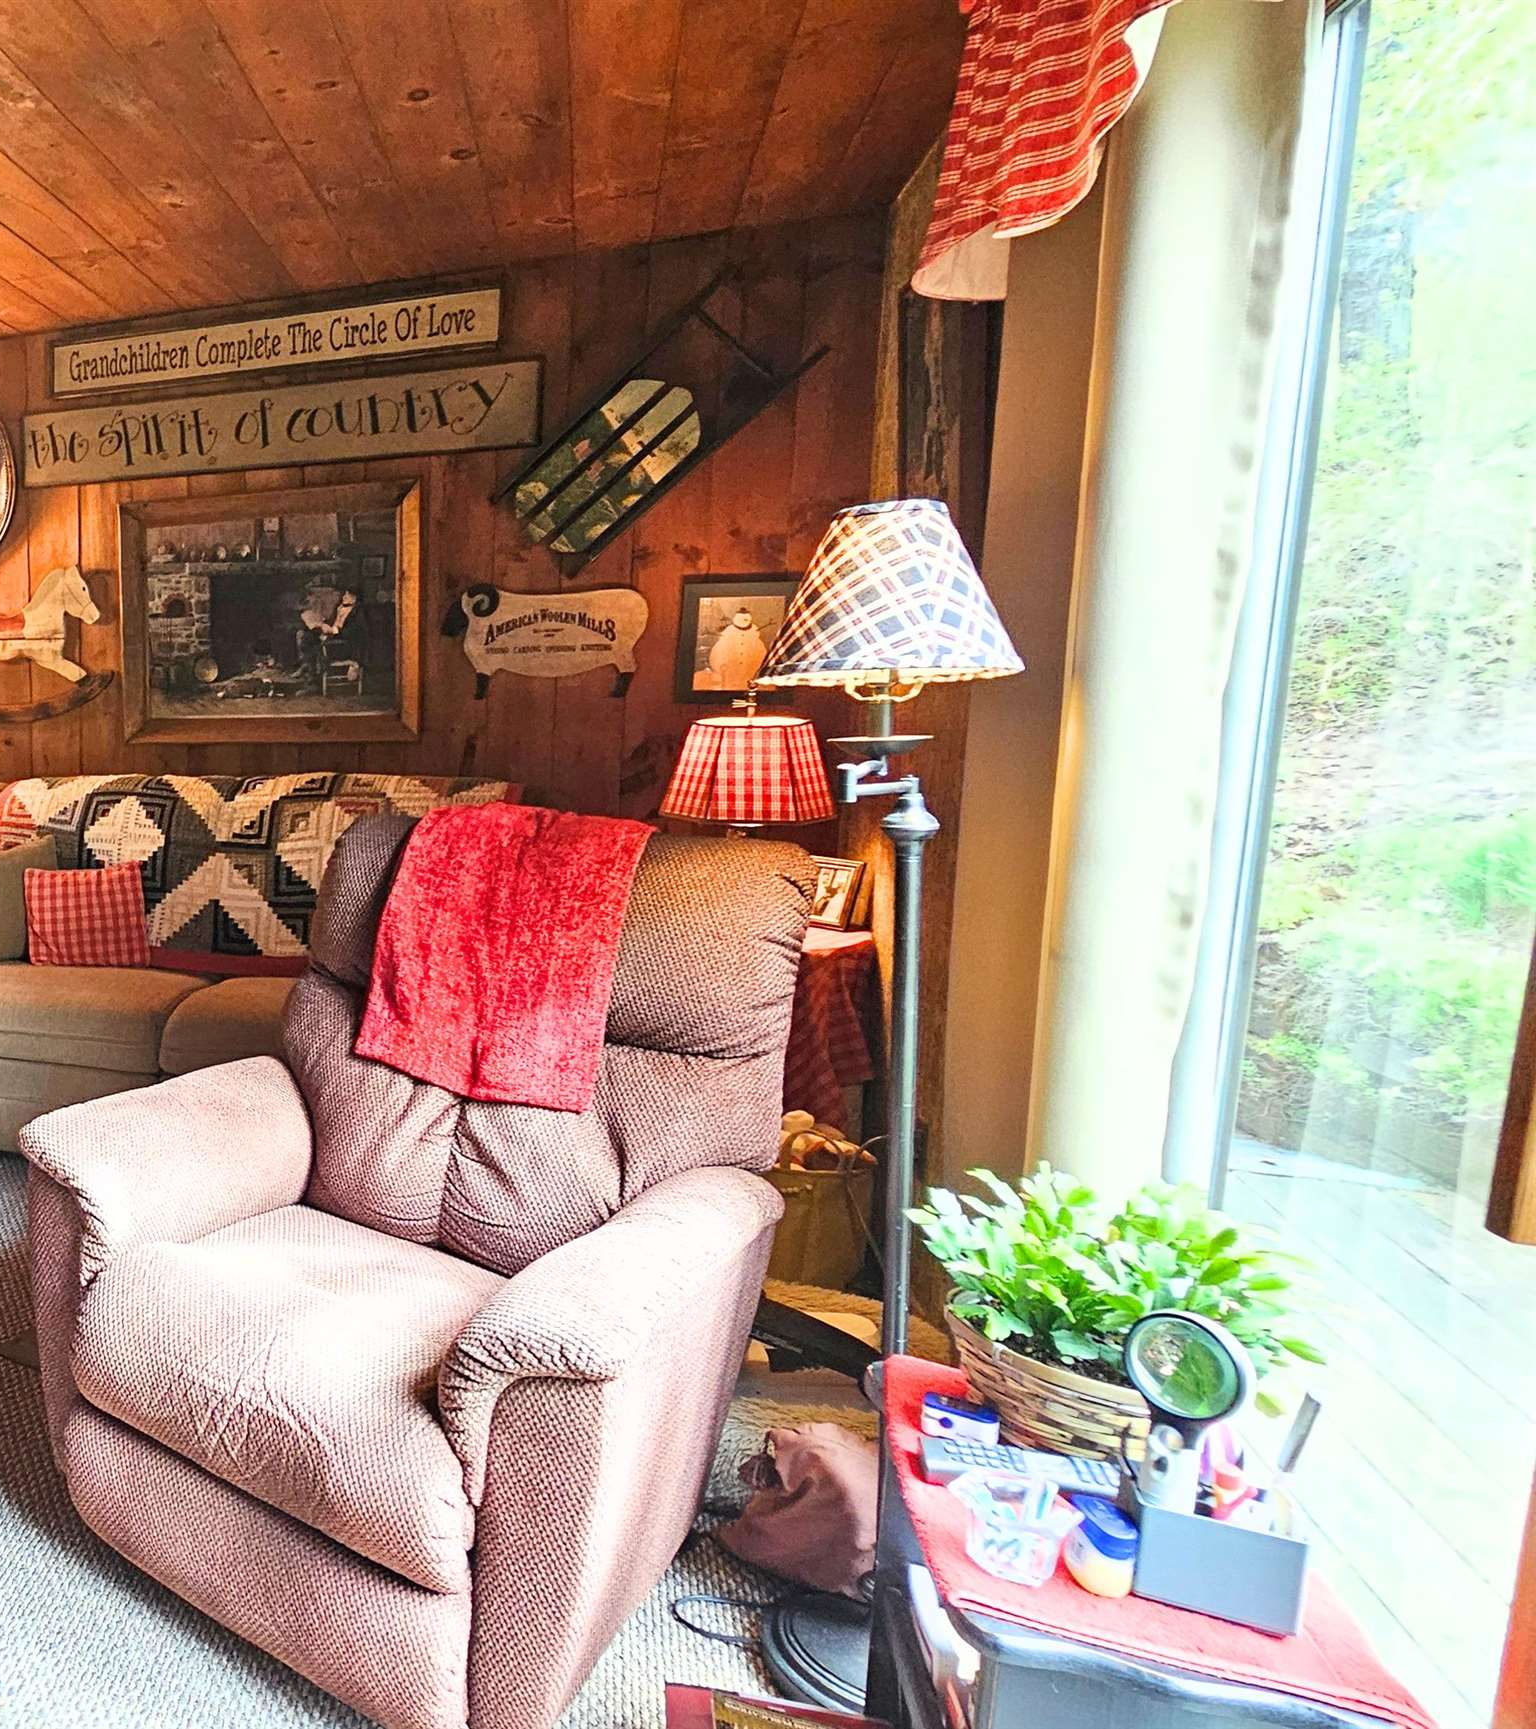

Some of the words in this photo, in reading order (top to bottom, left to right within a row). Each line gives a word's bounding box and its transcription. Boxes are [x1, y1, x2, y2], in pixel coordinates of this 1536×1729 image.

[69, 341, 190, 383] Grandchildren
[196, 327, 281, 368] Complete
[288, 322, 322, 356] The
[329, 312, 387, 352] Circle
[395, 305, 421, 342] Of
[427, 303, 476, 338] Love
[29, 421, 90, 470] the
[234, 397, 275, 449] of
[286, 371, 514, 444] country
[484, 611, 540, 646] AMERICAN
[539, 608, 577, 625] WOOLEN
[577, 612, 617, 642] MILLS
